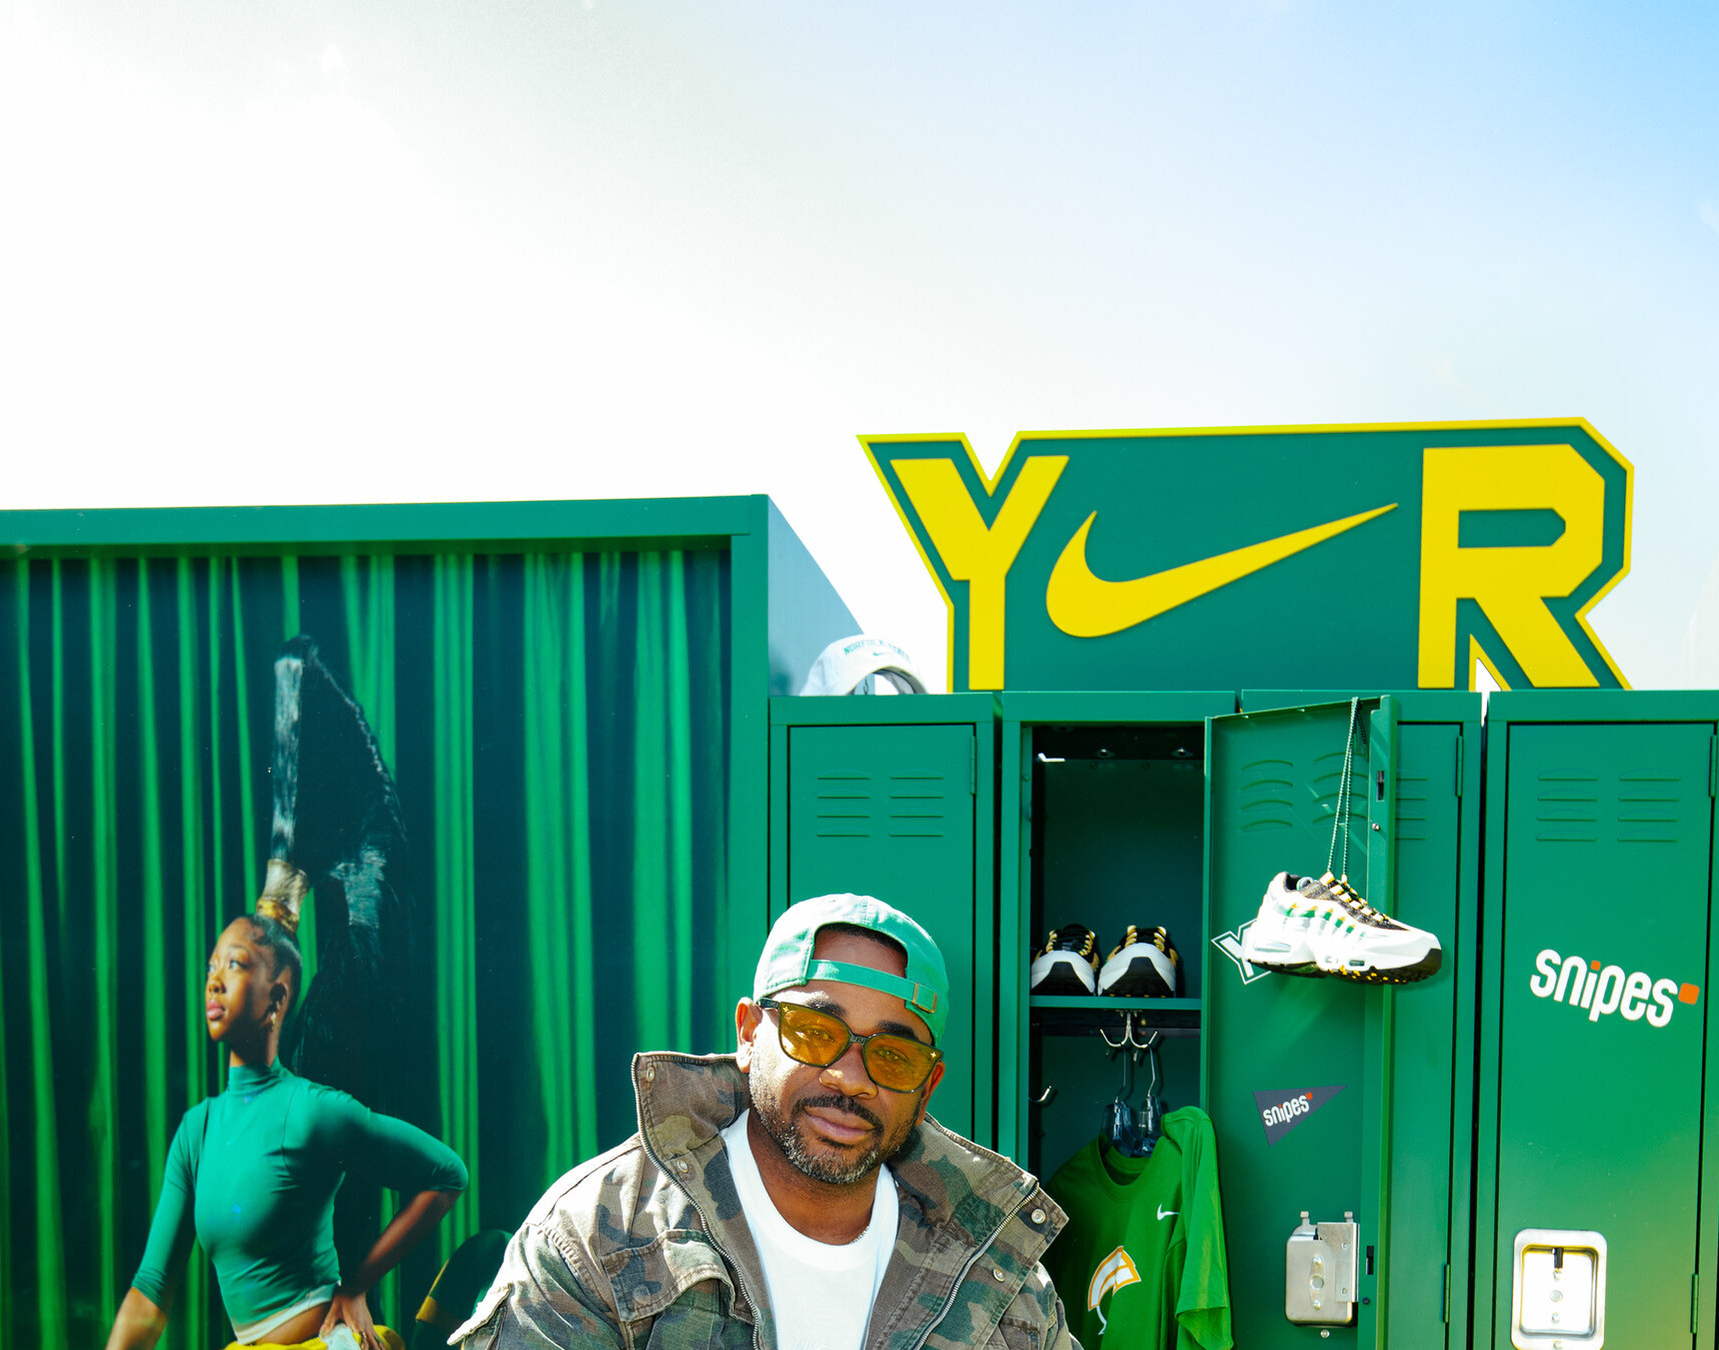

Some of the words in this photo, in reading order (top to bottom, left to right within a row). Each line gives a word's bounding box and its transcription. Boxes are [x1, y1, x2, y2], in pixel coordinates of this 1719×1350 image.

[890, 454, 1070, 691] Y
[1418, 443, 1601, 690] R
[1529, 948, 1679, 1028] snipes
[1262, 1095, 1310, 1127] snipes
